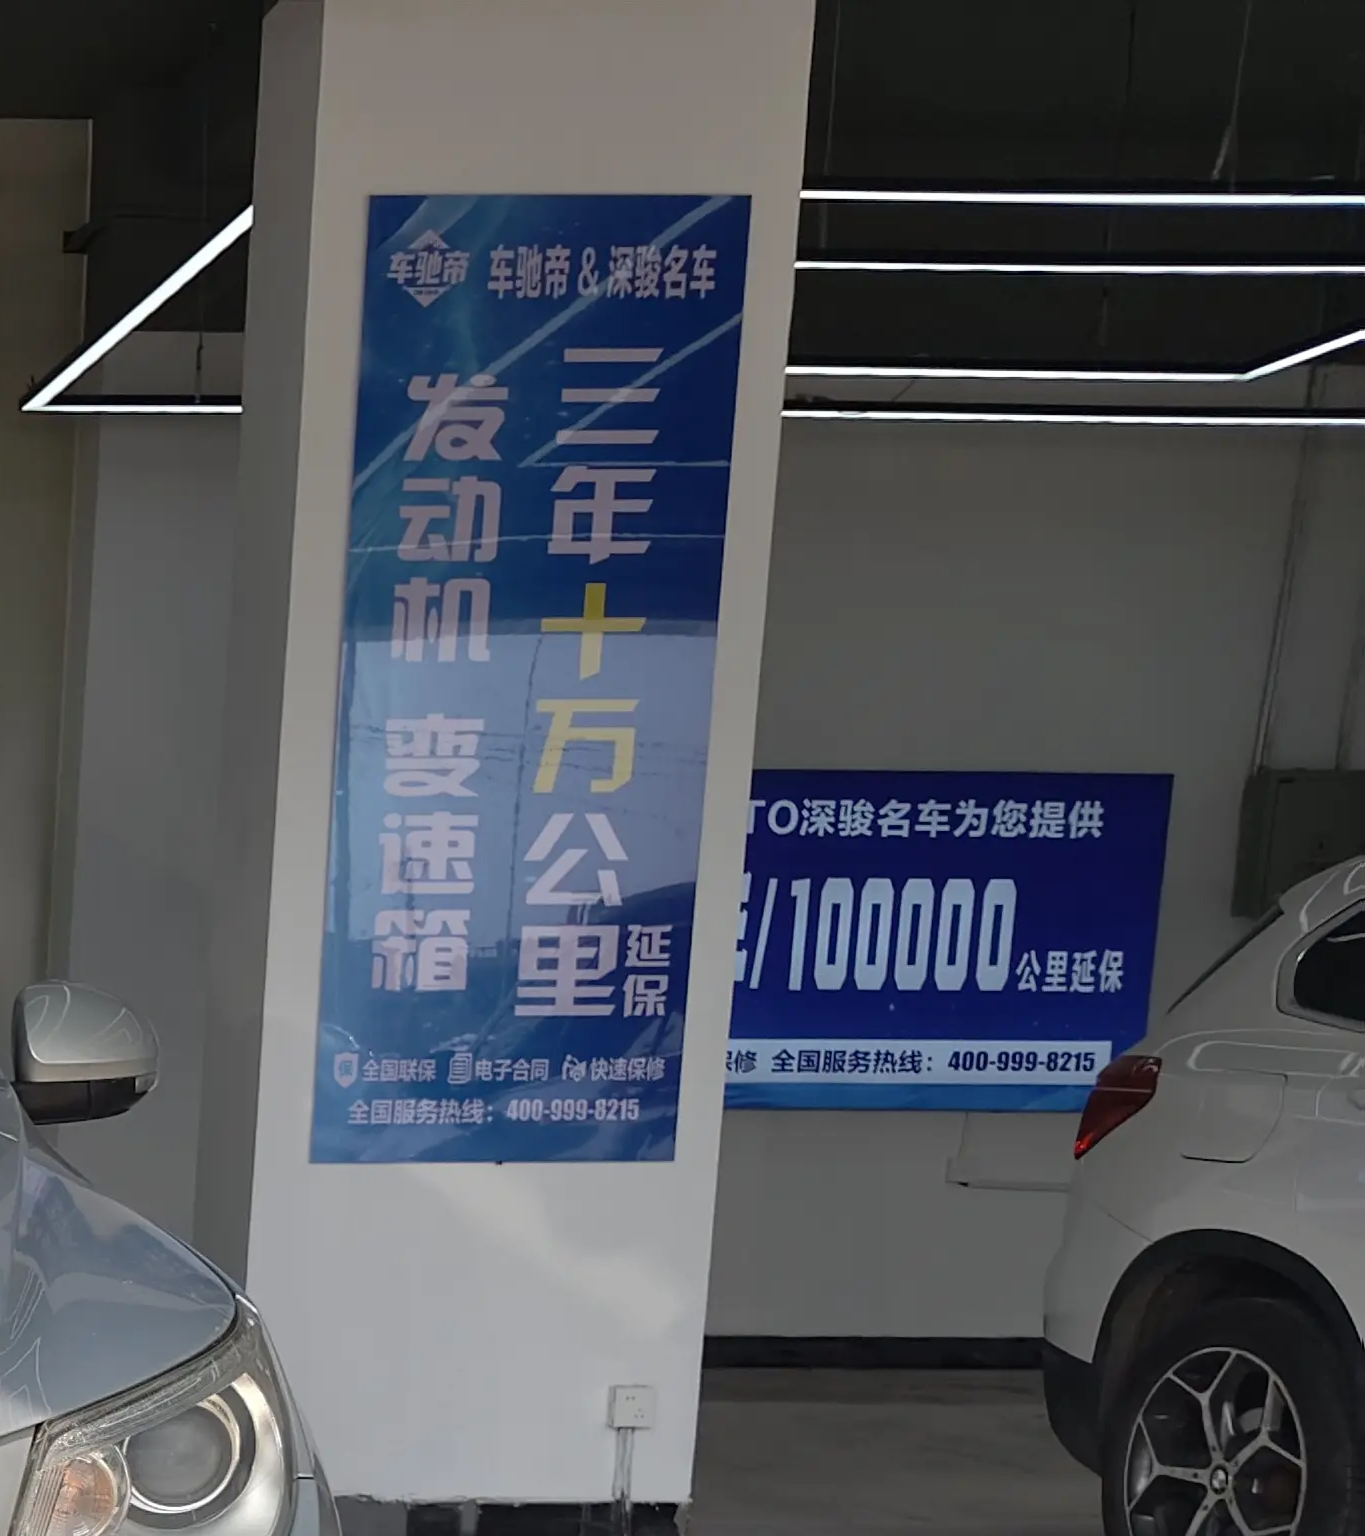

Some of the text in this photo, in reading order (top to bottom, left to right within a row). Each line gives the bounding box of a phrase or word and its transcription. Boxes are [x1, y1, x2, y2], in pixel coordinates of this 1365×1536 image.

[387, 249, 470, 286] 车驰帝
[488, 243, 717, 300] 车驰帝 & 深骏名车
[390, 373, 509, 663] 发动机
[514, 347, 665, 1017] 三年十万公里
[371, 713, 485, 993] 变速箱
[622, 924, 673, 1017] 延保
[1016, 949, 1124, 993] 公里延保
[362, 1058, 436, 1082] 全国联保
[474, 1058, 550, 1082] 电子合同
[589, 1057, 666, 1082] 快速保修
